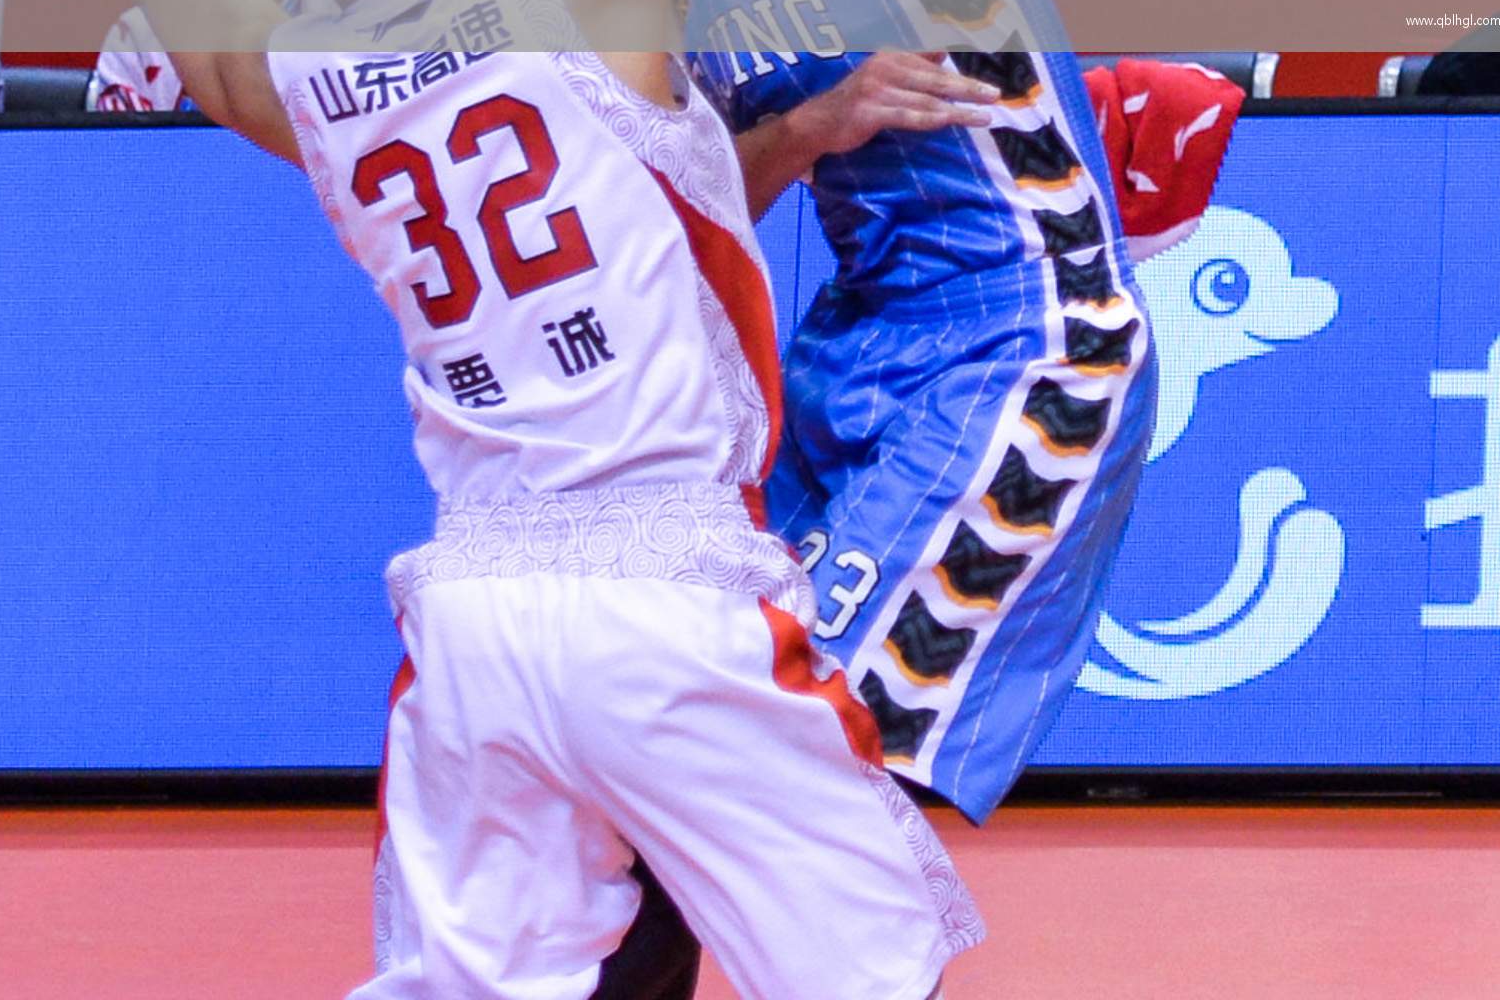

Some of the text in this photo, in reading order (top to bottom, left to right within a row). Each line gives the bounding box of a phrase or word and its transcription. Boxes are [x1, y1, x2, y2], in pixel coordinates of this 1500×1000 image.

[309, 0, 515, 124] 山东高速
[350, 92, 600, 331] 32
